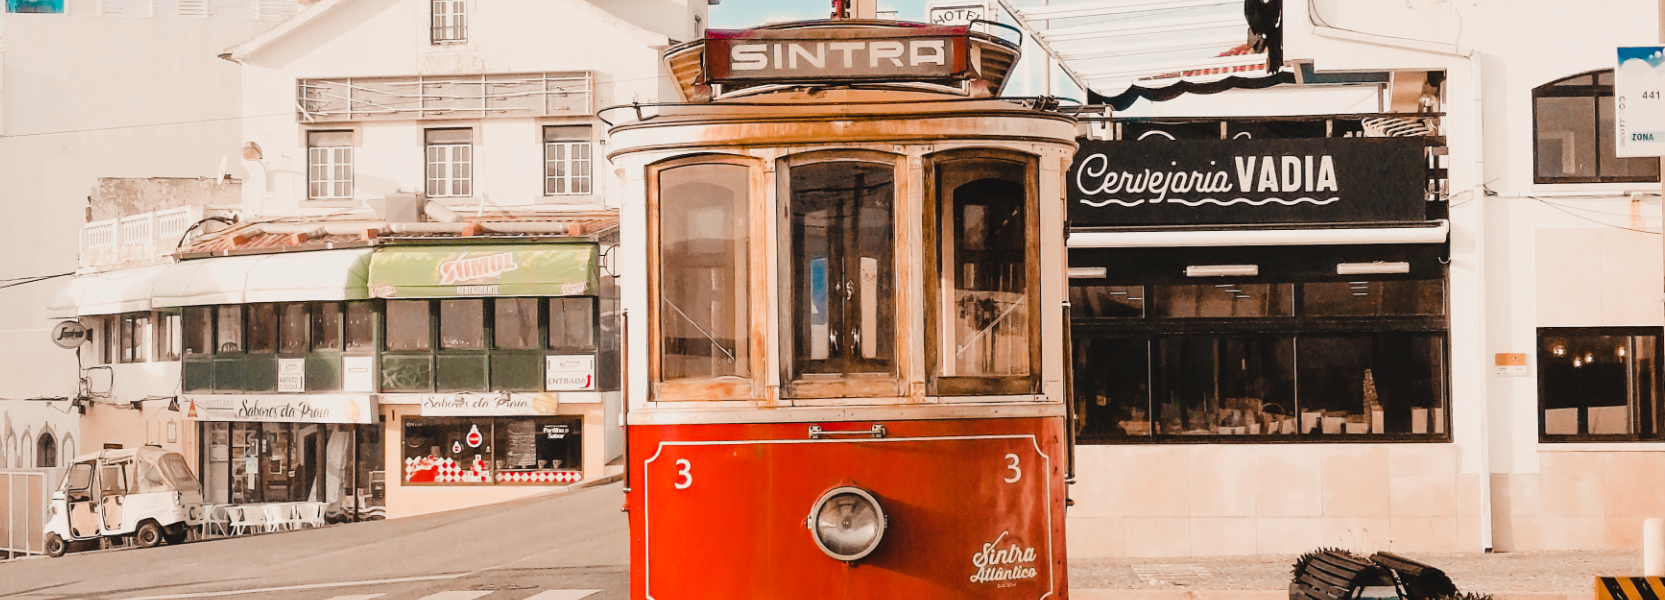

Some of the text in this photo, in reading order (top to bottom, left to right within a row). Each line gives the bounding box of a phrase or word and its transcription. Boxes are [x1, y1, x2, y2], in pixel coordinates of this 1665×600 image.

[934, 9, 983, 26] HOTEL
[731, 39, 946, 71] SINTRA
[1642, 91, 1660, 99] 441
[1632, 133, 1655, 141] ZONA
[1076, 152, 1339, 204] Cervejaria VADIA
[439, 252, 519, 286] SUMOL
[456, 286, 499, 295] RESTAURANTE
[547, 378, 586, 386] ENTRADA
[238, 399, 278, 419] Sabores
[280, 404, 296, 419] da
[298, 401, 330, 420] Praia
[472, 397, 490, 409] da
[674, 458, 693, 489] 3
[1004, 453, 1022, 483] 3
[972, 531, 1037, 568] Sintra
[970, 565, 1037, 583] Atlântico
